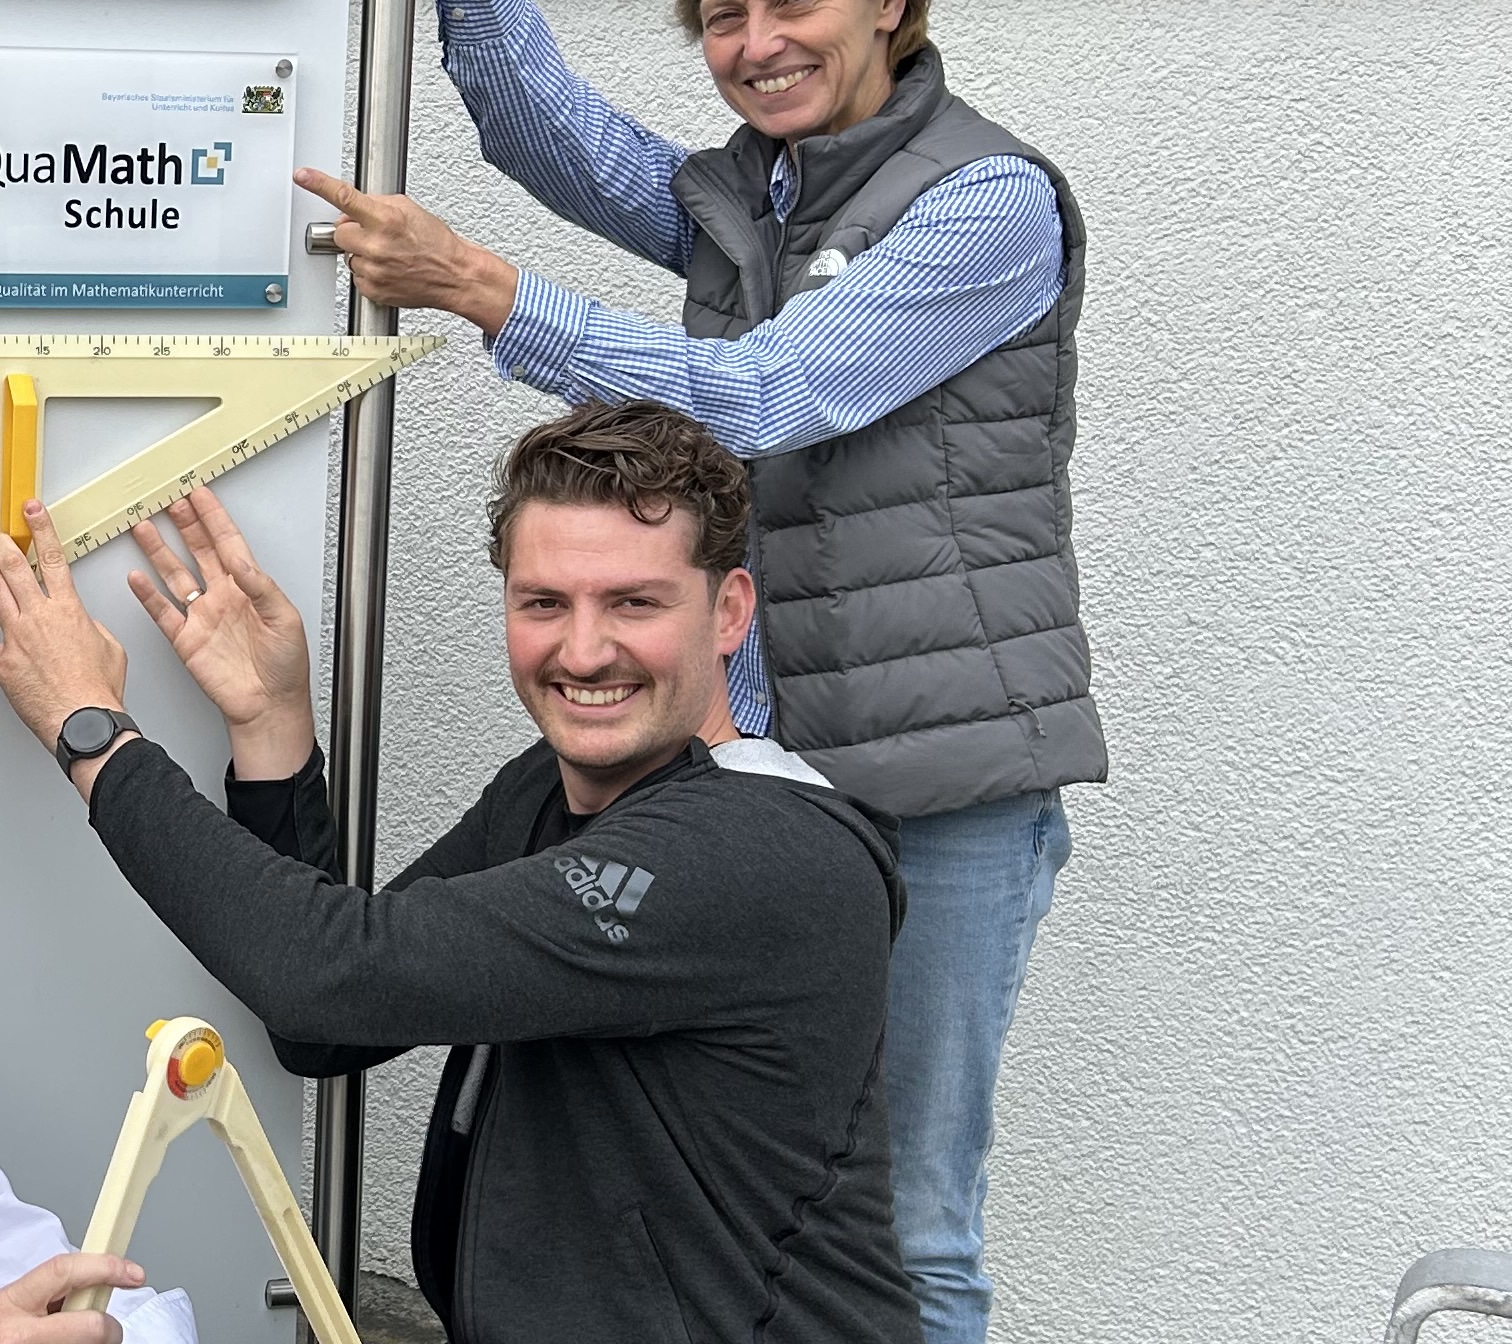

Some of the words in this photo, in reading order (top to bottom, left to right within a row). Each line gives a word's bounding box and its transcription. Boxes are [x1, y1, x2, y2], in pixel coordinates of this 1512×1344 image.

[102, 92, 149, 102] Bayerisches
[64, 198, 180, 229] Schule
[50, 284, 68, 297] im
[72, 283, 224, 298] Mathematikunterricht
[36, 346, 50, 355] 15
[93, 346, 112, 356] 20
[153, 347, 170, 356] 25
[213, 347, 231, 356] 30
[273, 347, 290, 356] 35
[332, 347, 350, 357] 40
[554, 855, 630, 945] adidas
